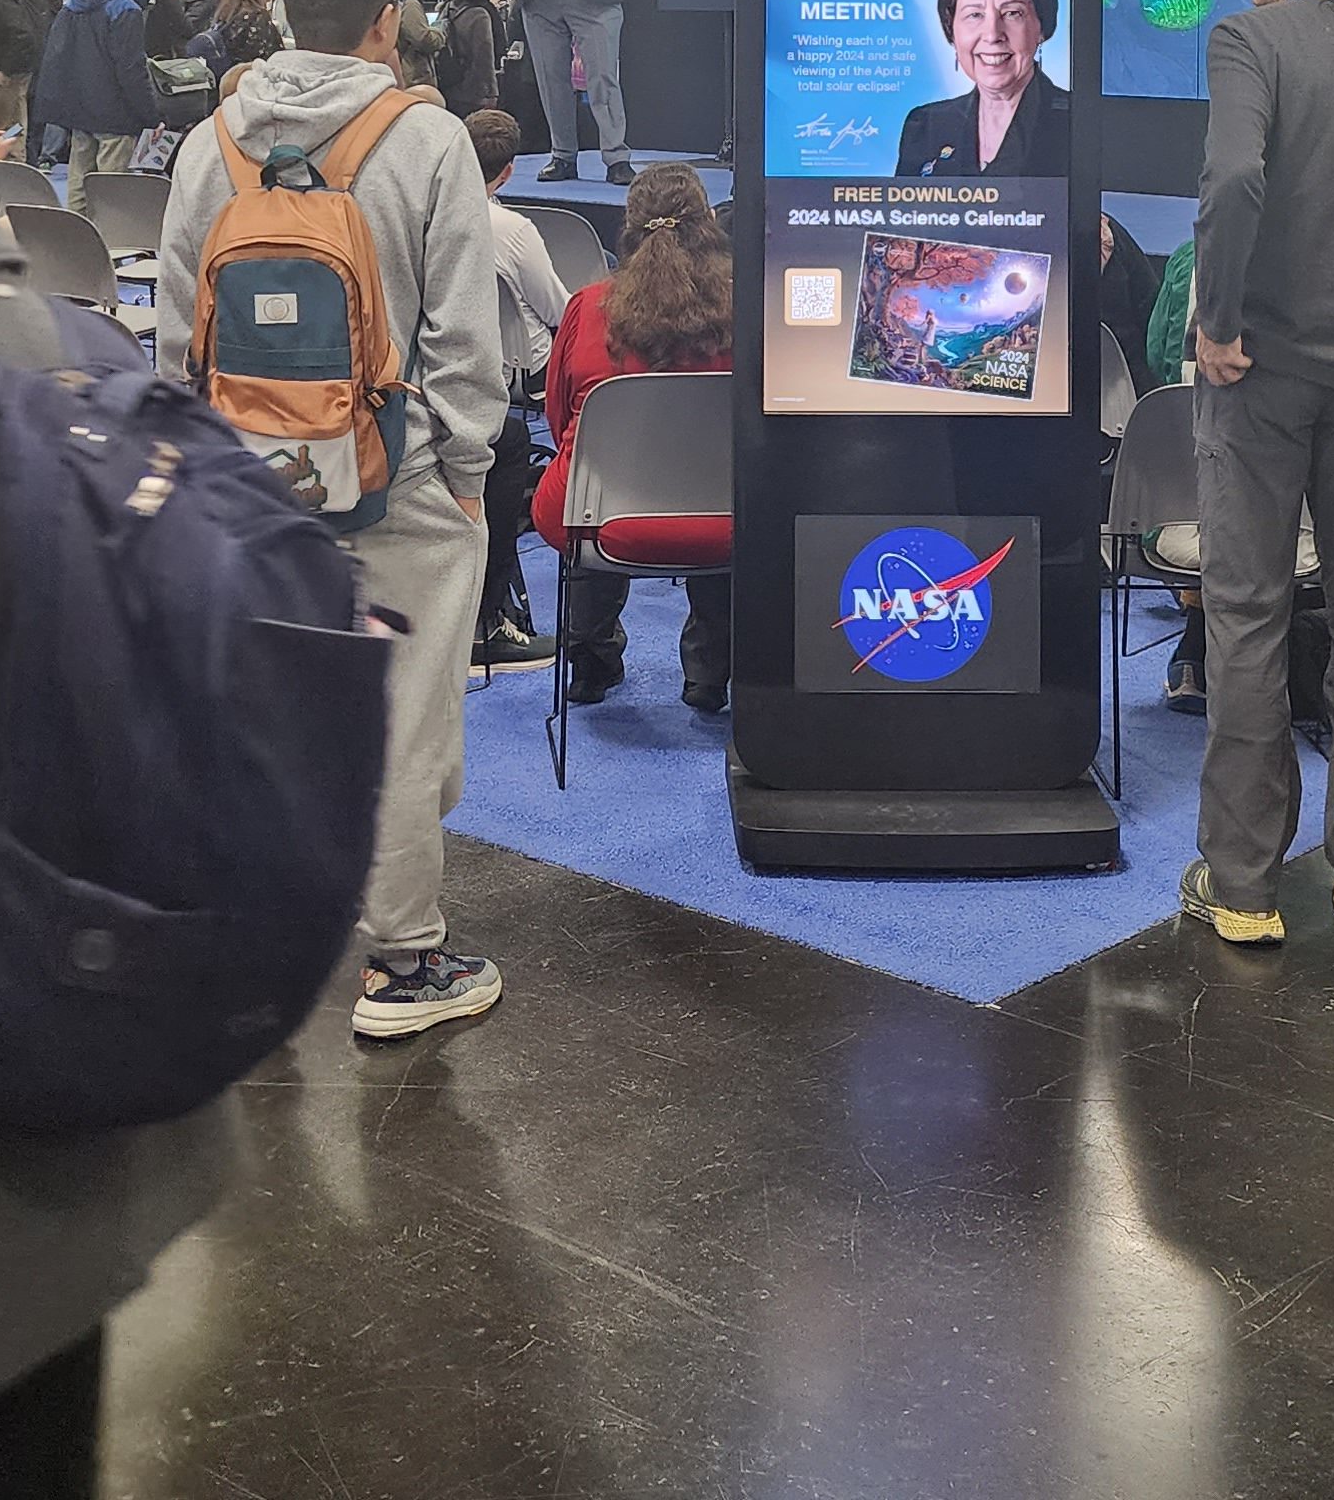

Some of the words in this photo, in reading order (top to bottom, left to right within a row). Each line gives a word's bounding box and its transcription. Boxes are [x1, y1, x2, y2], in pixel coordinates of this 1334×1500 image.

[801, 2, 904, 20] MEETING
[846, 35, 873, 46] each
[877, 35, 888, 46] of
[891, 37, 912, 48] you
[787, 52, 795, 61] a
[798, 50, 833, 63] happy
[836, 51, 864, 61] 2024
[868, 50, 889, 61] and
[892, 50, 916, 61] safe
[793, 65, 835, 78] viewing
[839, 65, 851, 76] of
[853, 65, 871, 76] the
[874, 65, 900, 78] April
[904, 66, 911, 76] 8
[798, 81, 822, 91] total
[826, 81, 853, 91] solar
[833, 187, 883, 202] FREE
[887, 187, 999, 203] DOWNLOAD
[788, 209, 830, 225] 2024
[835, 209, 885, 225] NASA
[889, 210, 959, 226] Science
[964, 211, 1045, 227] Calendar
[999, 350, 1029, 363] 2024
[985, 361, 1028, 378] NASA
[972, 373, 1027, 391] SCIENCE
[852, 588, 984, 622] NASA
